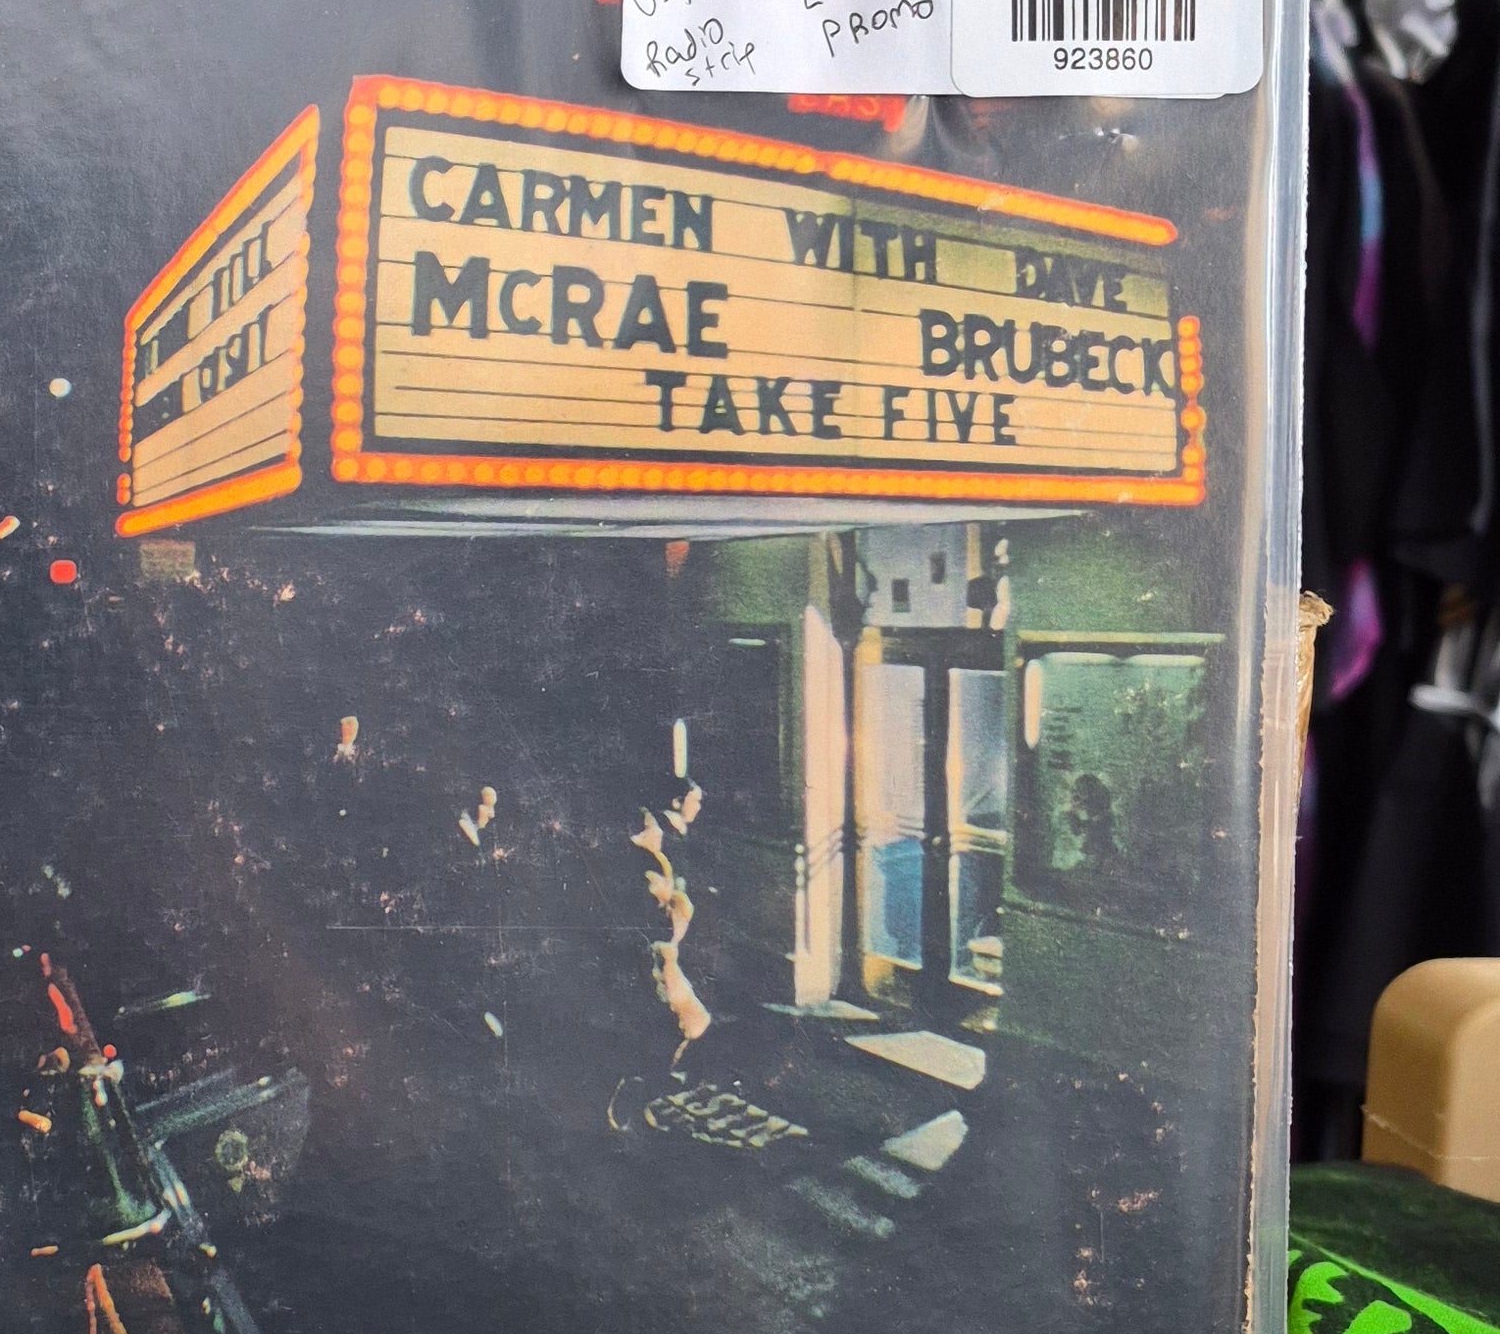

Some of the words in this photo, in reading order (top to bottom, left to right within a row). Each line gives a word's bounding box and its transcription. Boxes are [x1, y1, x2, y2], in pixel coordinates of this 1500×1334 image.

[645, 18, 725, 78] Radio
[1053, 47, 1154, 71] 923860
[408, 154, 714, 254] CARMEN
[783, 208, 938, 284] WITH
[1014, 246, 1128, 313] DAVE
[919, 308, 1177, 399] BRUBECK
[644, 368, 842, 440] TAKE
[883, 384, 1017, 447] FIVE
